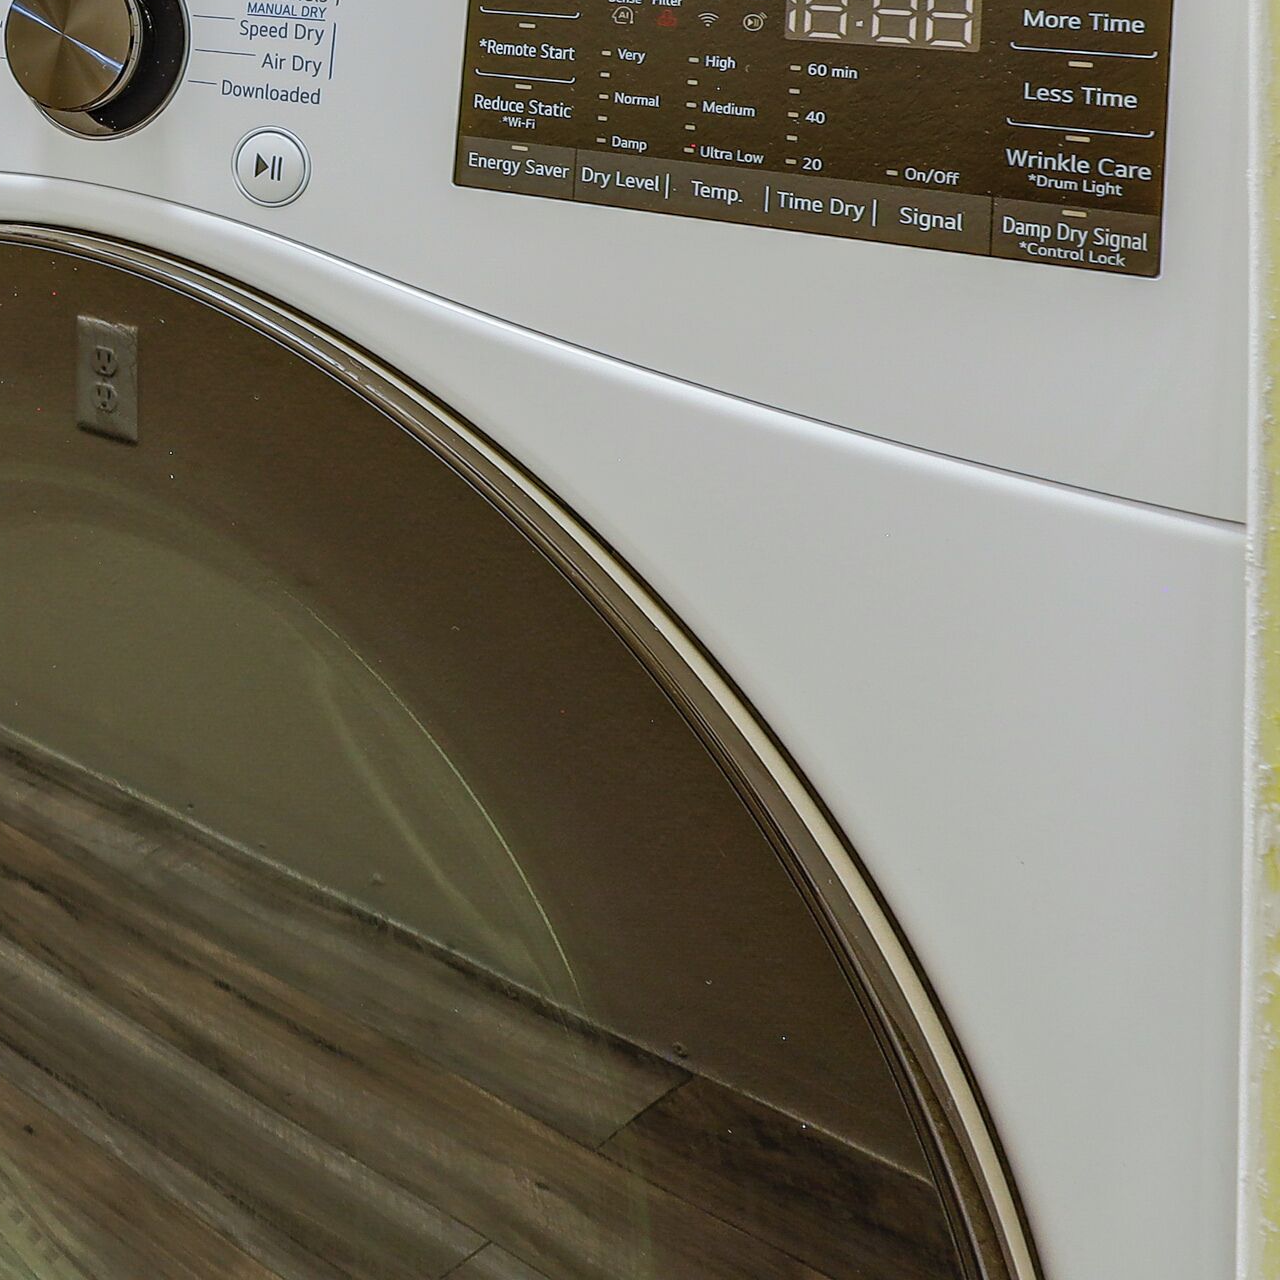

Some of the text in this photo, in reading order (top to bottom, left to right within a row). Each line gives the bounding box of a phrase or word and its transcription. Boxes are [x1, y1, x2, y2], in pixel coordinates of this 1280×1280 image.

[247, 1, 327, 19] MANUAL DRY
[1023, 9, 1145, 34] More Time
[239, 20, 325, 46] Speed Dry
[540, 43, 576, 61] Start
[617, 47, 646, 64] Very
[261, 52, 322, 78] Air Dry
[705, 55, 736, 72] High
[807, 63, 858, 80] 60 min
[221, 79, 321, 105] Downloaded
[614, 91, 661, 108] Normal
[1023, 82, 1138, 109] Less Time
[473, 93, 572, 119] Reduce Static
[702, 100, 756, 117] Medium
[805, 111, 826, 124] 40
[611, 135, 648, 153] Damp
[468, 151, 570, 179] Energy Saver
[699, 145, 765, 165] Ultra Low
[802, 157, 823, 171] 20
[1005, 147, 1152, 181] Wrinkle Care
[581, 166, 660, 192] Dry Level
[904, 166, 960, 186] On/Off
[691, 180, 744, 206] Temp.
[1082, 179, 1123, 197] Light
[776, 190, 865, 222] Time Dry
[899, 206, 964, 232] Signal
[1002, 216, 1148, 253] Damp Dry Signal
[1089, 250, 1126, 267] Lock
